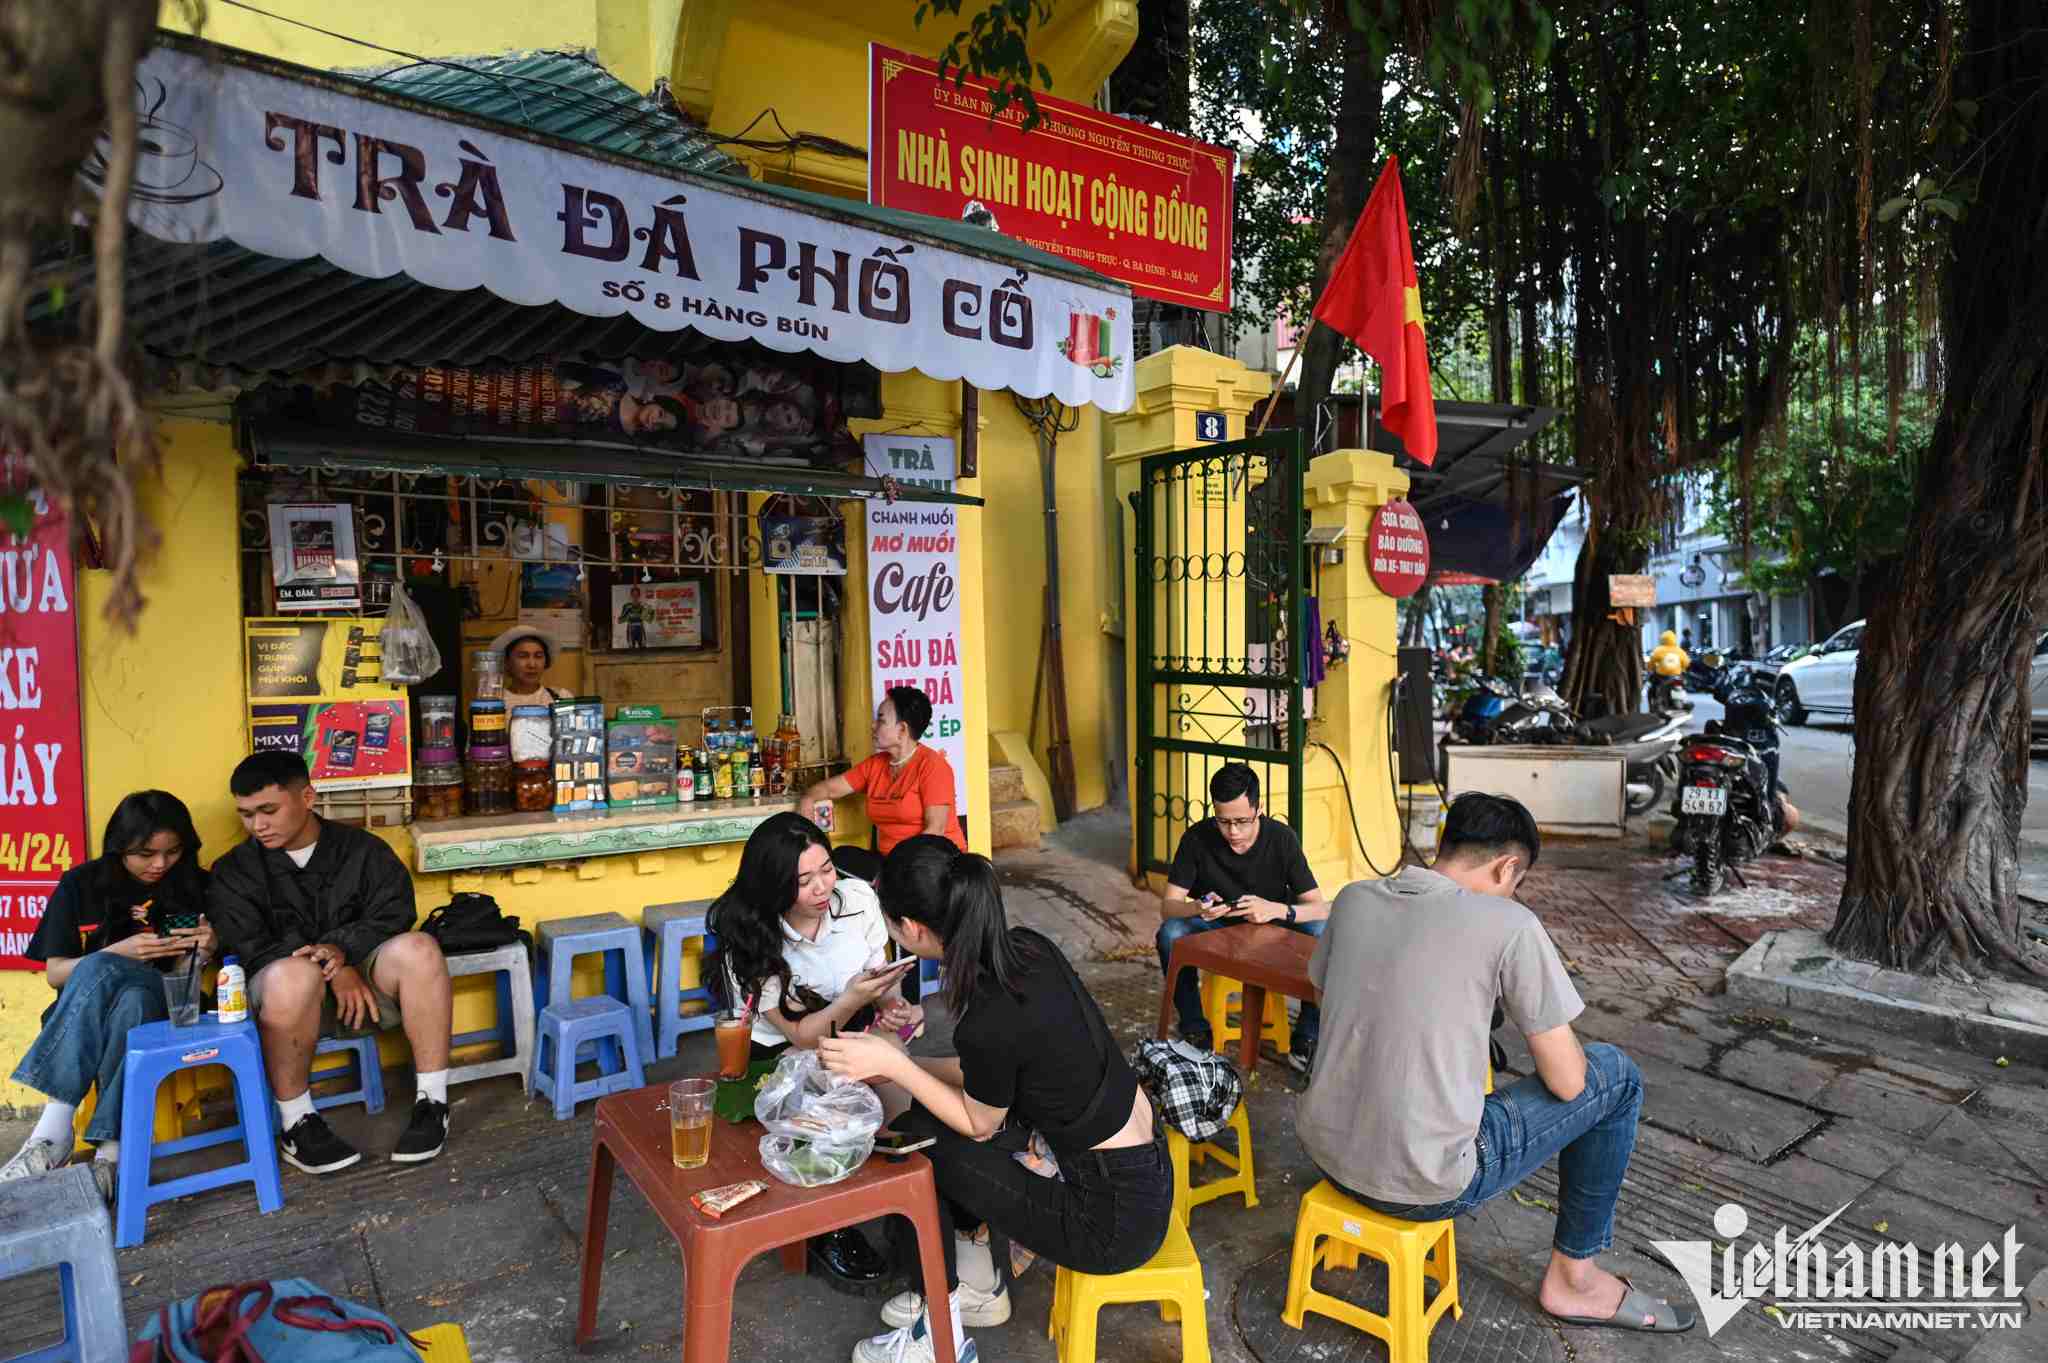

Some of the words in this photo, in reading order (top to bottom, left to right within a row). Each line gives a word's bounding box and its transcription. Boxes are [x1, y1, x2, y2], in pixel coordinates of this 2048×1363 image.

[953, 90, 979, 111] BAN
[1132, 144, 1166, 163] TRUNG
[897, 124, 952, 192] NHÀ
[959, 145, 1020, 206] SINH
[1025, 161, 1084, 229] HOẠT
[1090, 173, 1148, 240] CỘNG
[1153, 184, 1208, 252] ĐỒNG
[264, 110, 517, 242] TRÀ
[556, 183, 701, 282] ĐÁ
[736, 226, 915, 325] PHỐ
[942, 270, 1035, 350] CỔ
[1064, 246, 1096, 261] TRUNG
[602, 279, 645, 302] SỐ
[655, 291, 671, 310] 8
[681, 294, 769, 328] HÀNG
[776, 315, 830, 342] BÚN
[1204, 416, 1218, 438] 8
[887, 443, 935, 471] TRÀ
[871, 510, 918, 524] CHANH
[920, 506, 954, 525] MUỐI
[871, 533, 903, 553] MƠ
[907, 529, 956, 553] MUỐI
[877, 628, 922, 669] SẤU
[928, 632, 958, 666] ĐÁ
[925, 670, 954, 705] ĐÁ
[254, 734, 283, 746] MIX
[940, 713, 962, 738] ÉP
[0, 723, 62, 807] ÁY
